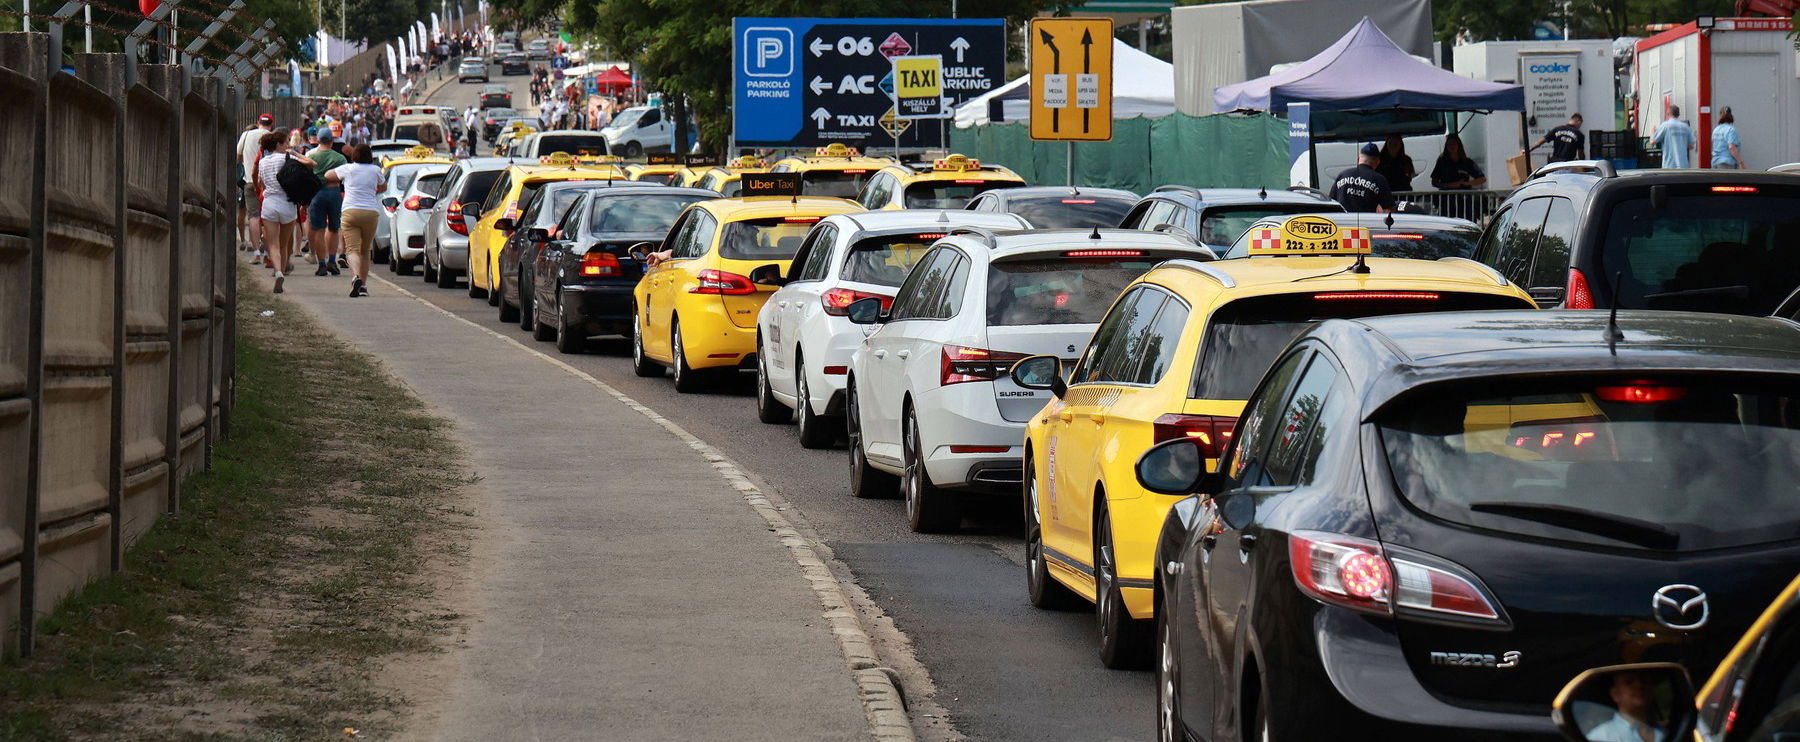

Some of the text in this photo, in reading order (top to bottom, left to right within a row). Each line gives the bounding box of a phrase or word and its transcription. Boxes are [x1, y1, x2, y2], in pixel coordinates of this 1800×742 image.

[757, 37, 783, 68] P
[1530, 62, 1571, 73] cooler
[746, 79, 791, 89] PARKOLÓ
[837, 74, 875, 94] AC
[900, 69, 936, 88] TAXI
[747, 89, 790, 98] PARKING
[903, 98, 936, 107] KISZÁLLÓ
[911, 105, 929, 113] HELY
[837, 115, 874, 127] TAXI
[749, 178, 795, 190] Uber Taxi
